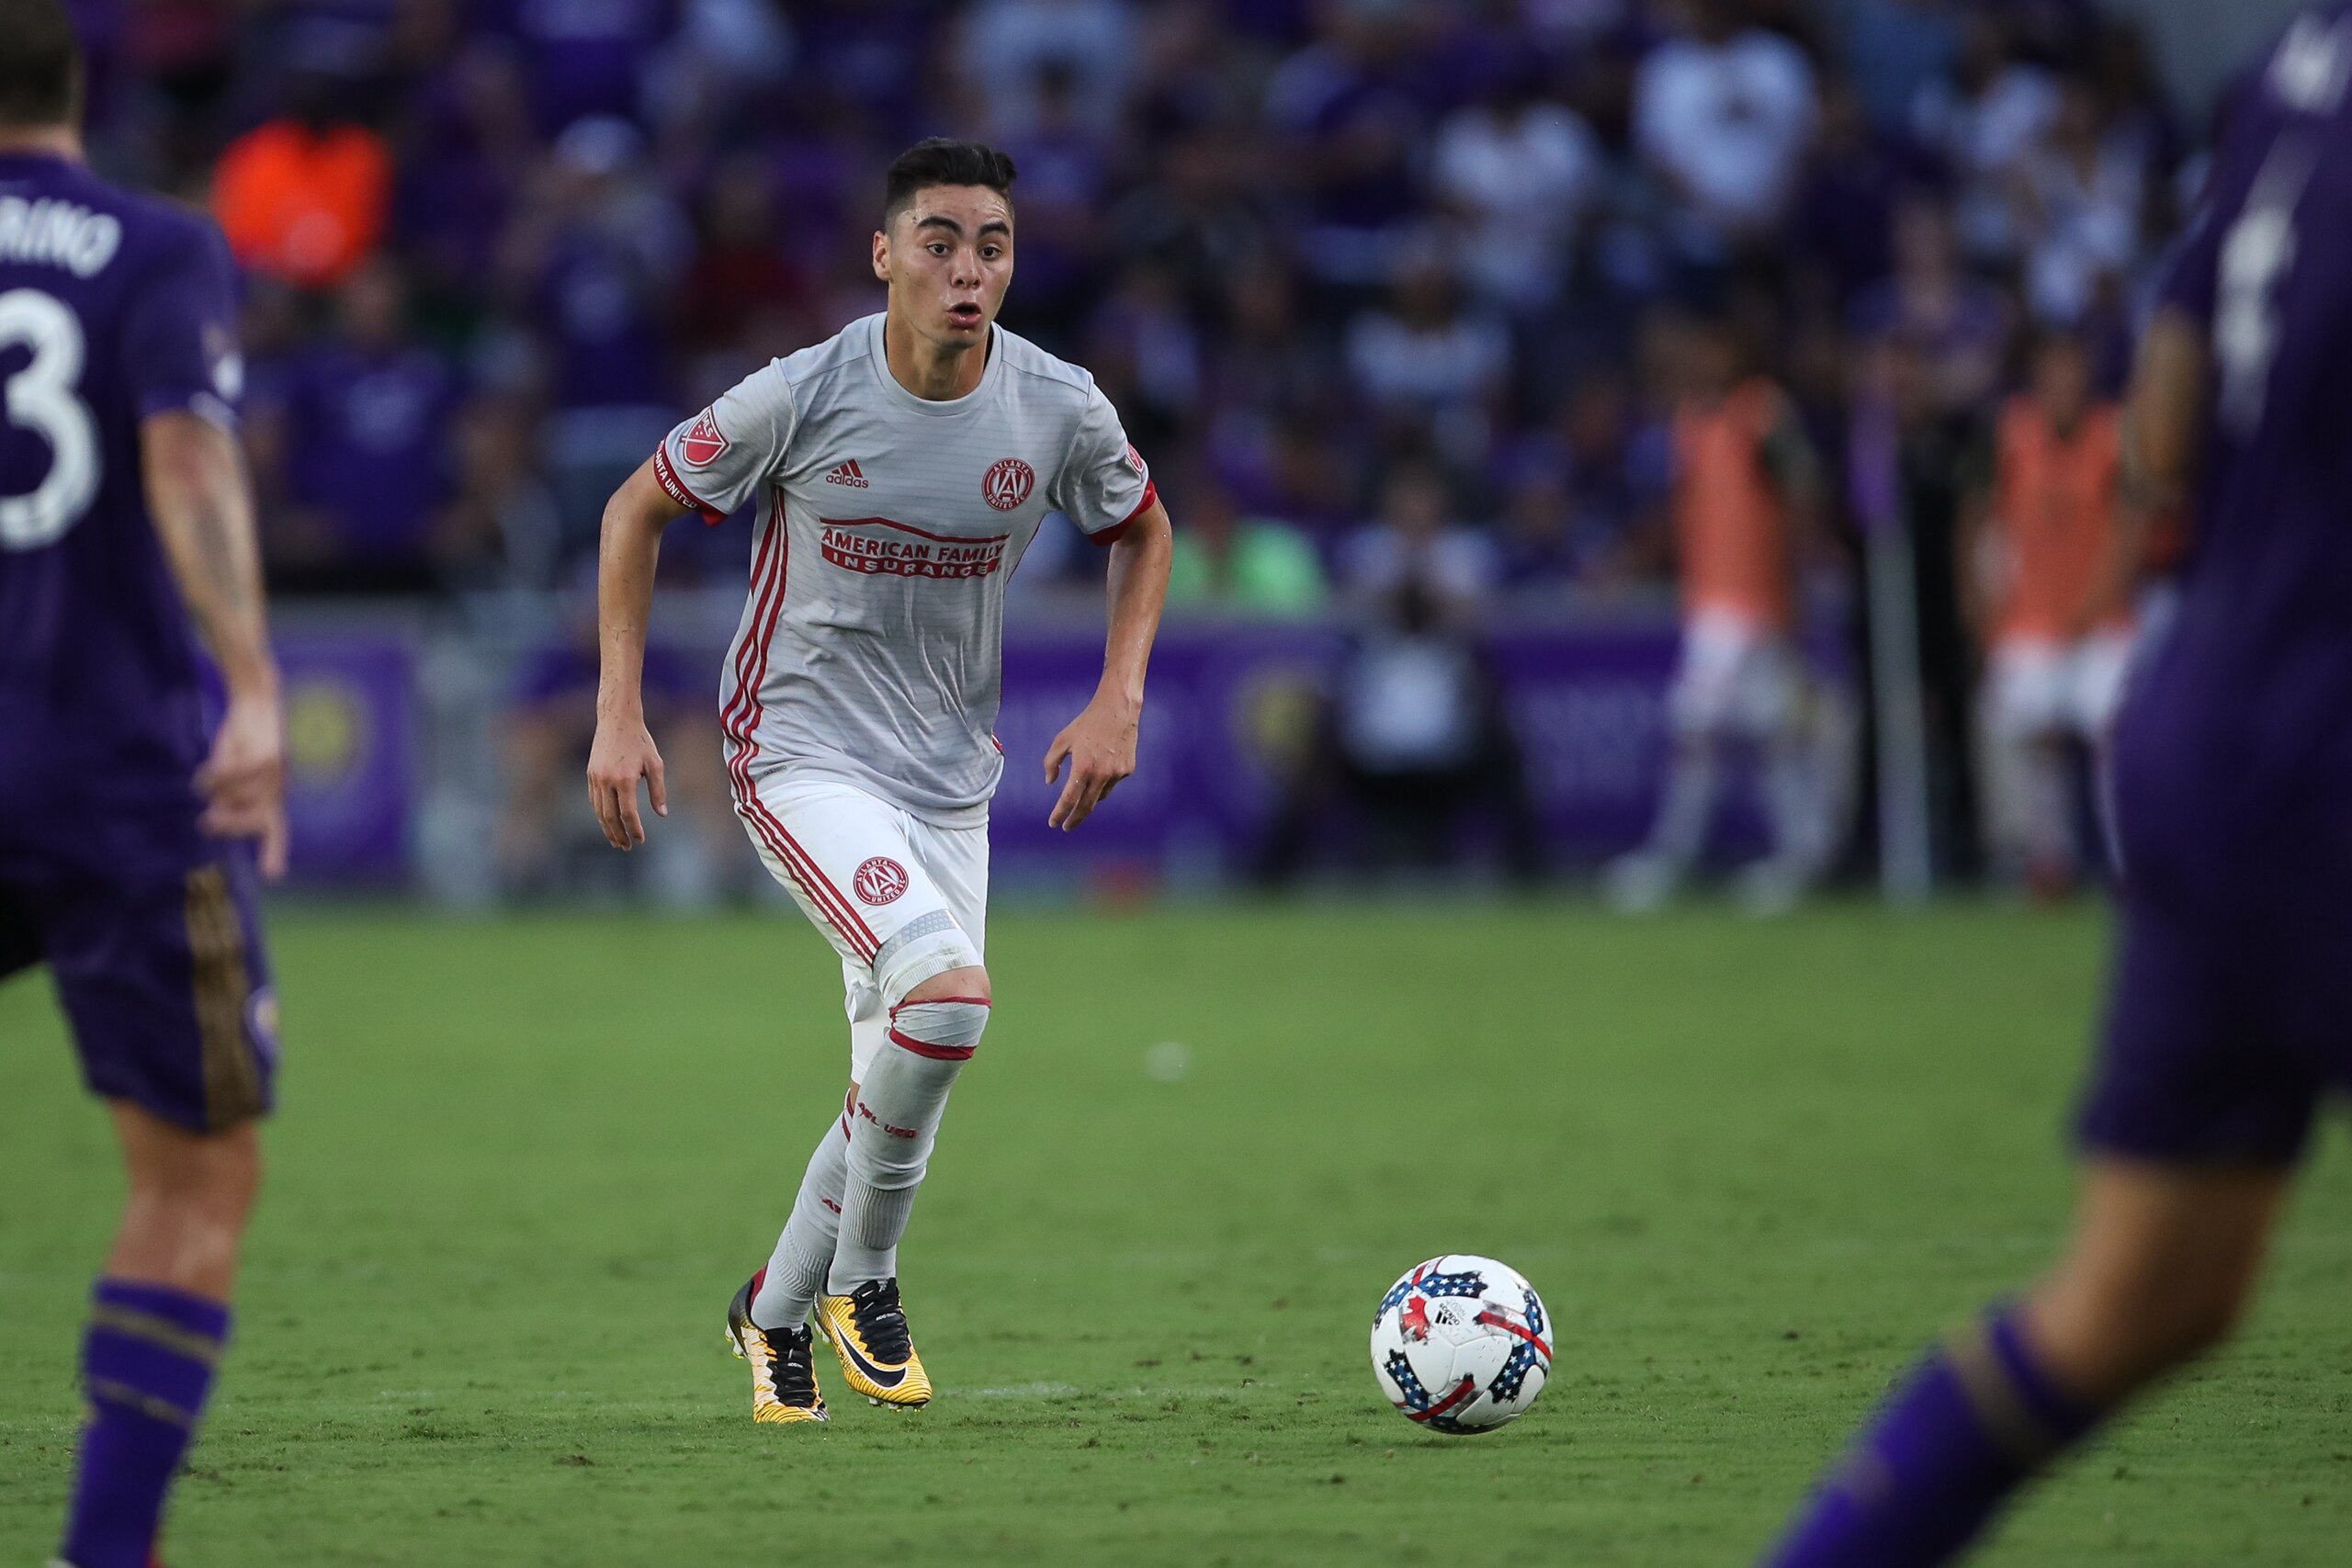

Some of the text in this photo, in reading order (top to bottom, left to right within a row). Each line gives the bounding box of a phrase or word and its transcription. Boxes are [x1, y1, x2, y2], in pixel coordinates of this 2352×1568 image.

[702, 413, 714, 437] MLS
[993, 460, 1029, 474] ATLANTA
[826, 473, 869, 489] adidas
[664, 479, 697, 508] UNITED
[988, 494, 1013, 509] UNITED
[821, 528, 1006, 562] AMERICAN FAMILY
[832, 552, 989, 576] INSURANCE
[856, 860, 888, 882] ATLANTA
[871, 889, 900, 903] UNITED
